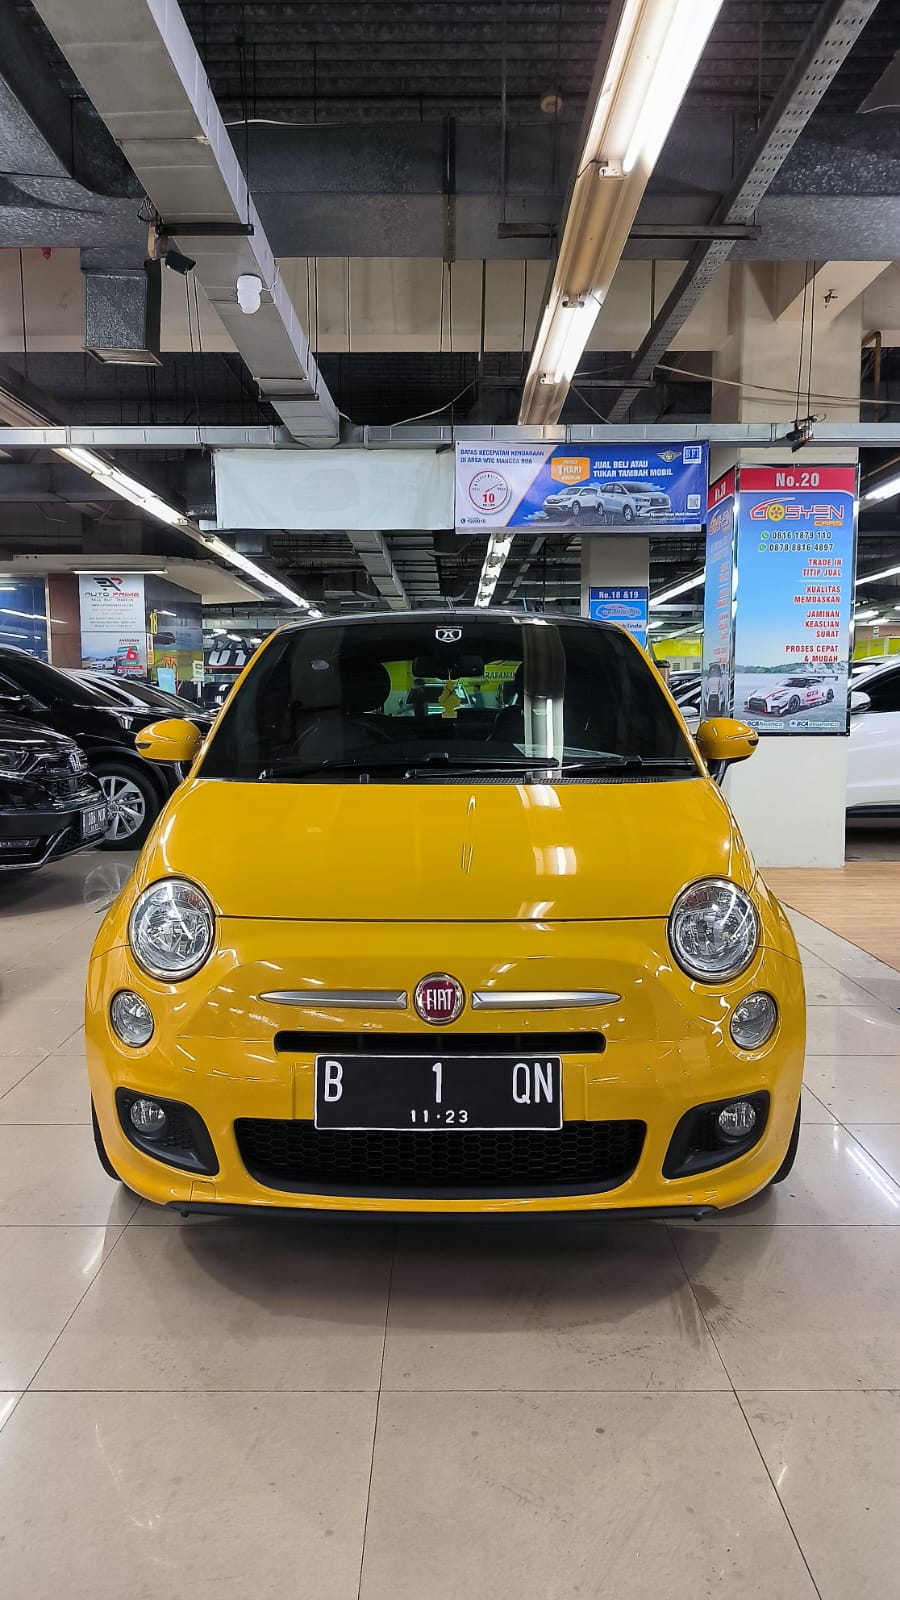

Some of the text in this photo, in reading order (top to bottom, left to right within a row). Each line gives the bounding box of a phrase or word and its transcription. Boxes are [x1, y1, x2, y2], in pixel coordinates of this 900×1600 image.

[685, 448, 700, 458] BFI
[593, 460, 648, 469] JUAL BELI ATAU
[593, 468, 673, 478] TUKAR TAMBAH MOBIL
[776, 472, 819, 487] No.20
[482, 494, 495, 503] 10
[769, 543, 789, 551] 0878
[814, 543, 833, 551] 4897
[803, 569, 842, 577] TITIP JUAL
[599, 591, 620, 599] No.18
[806, 610, 840, 618] JAMINAN
[426, 989, 453, 1010] FIAT
[324, 1061, 553, 1104] B 1 QN
